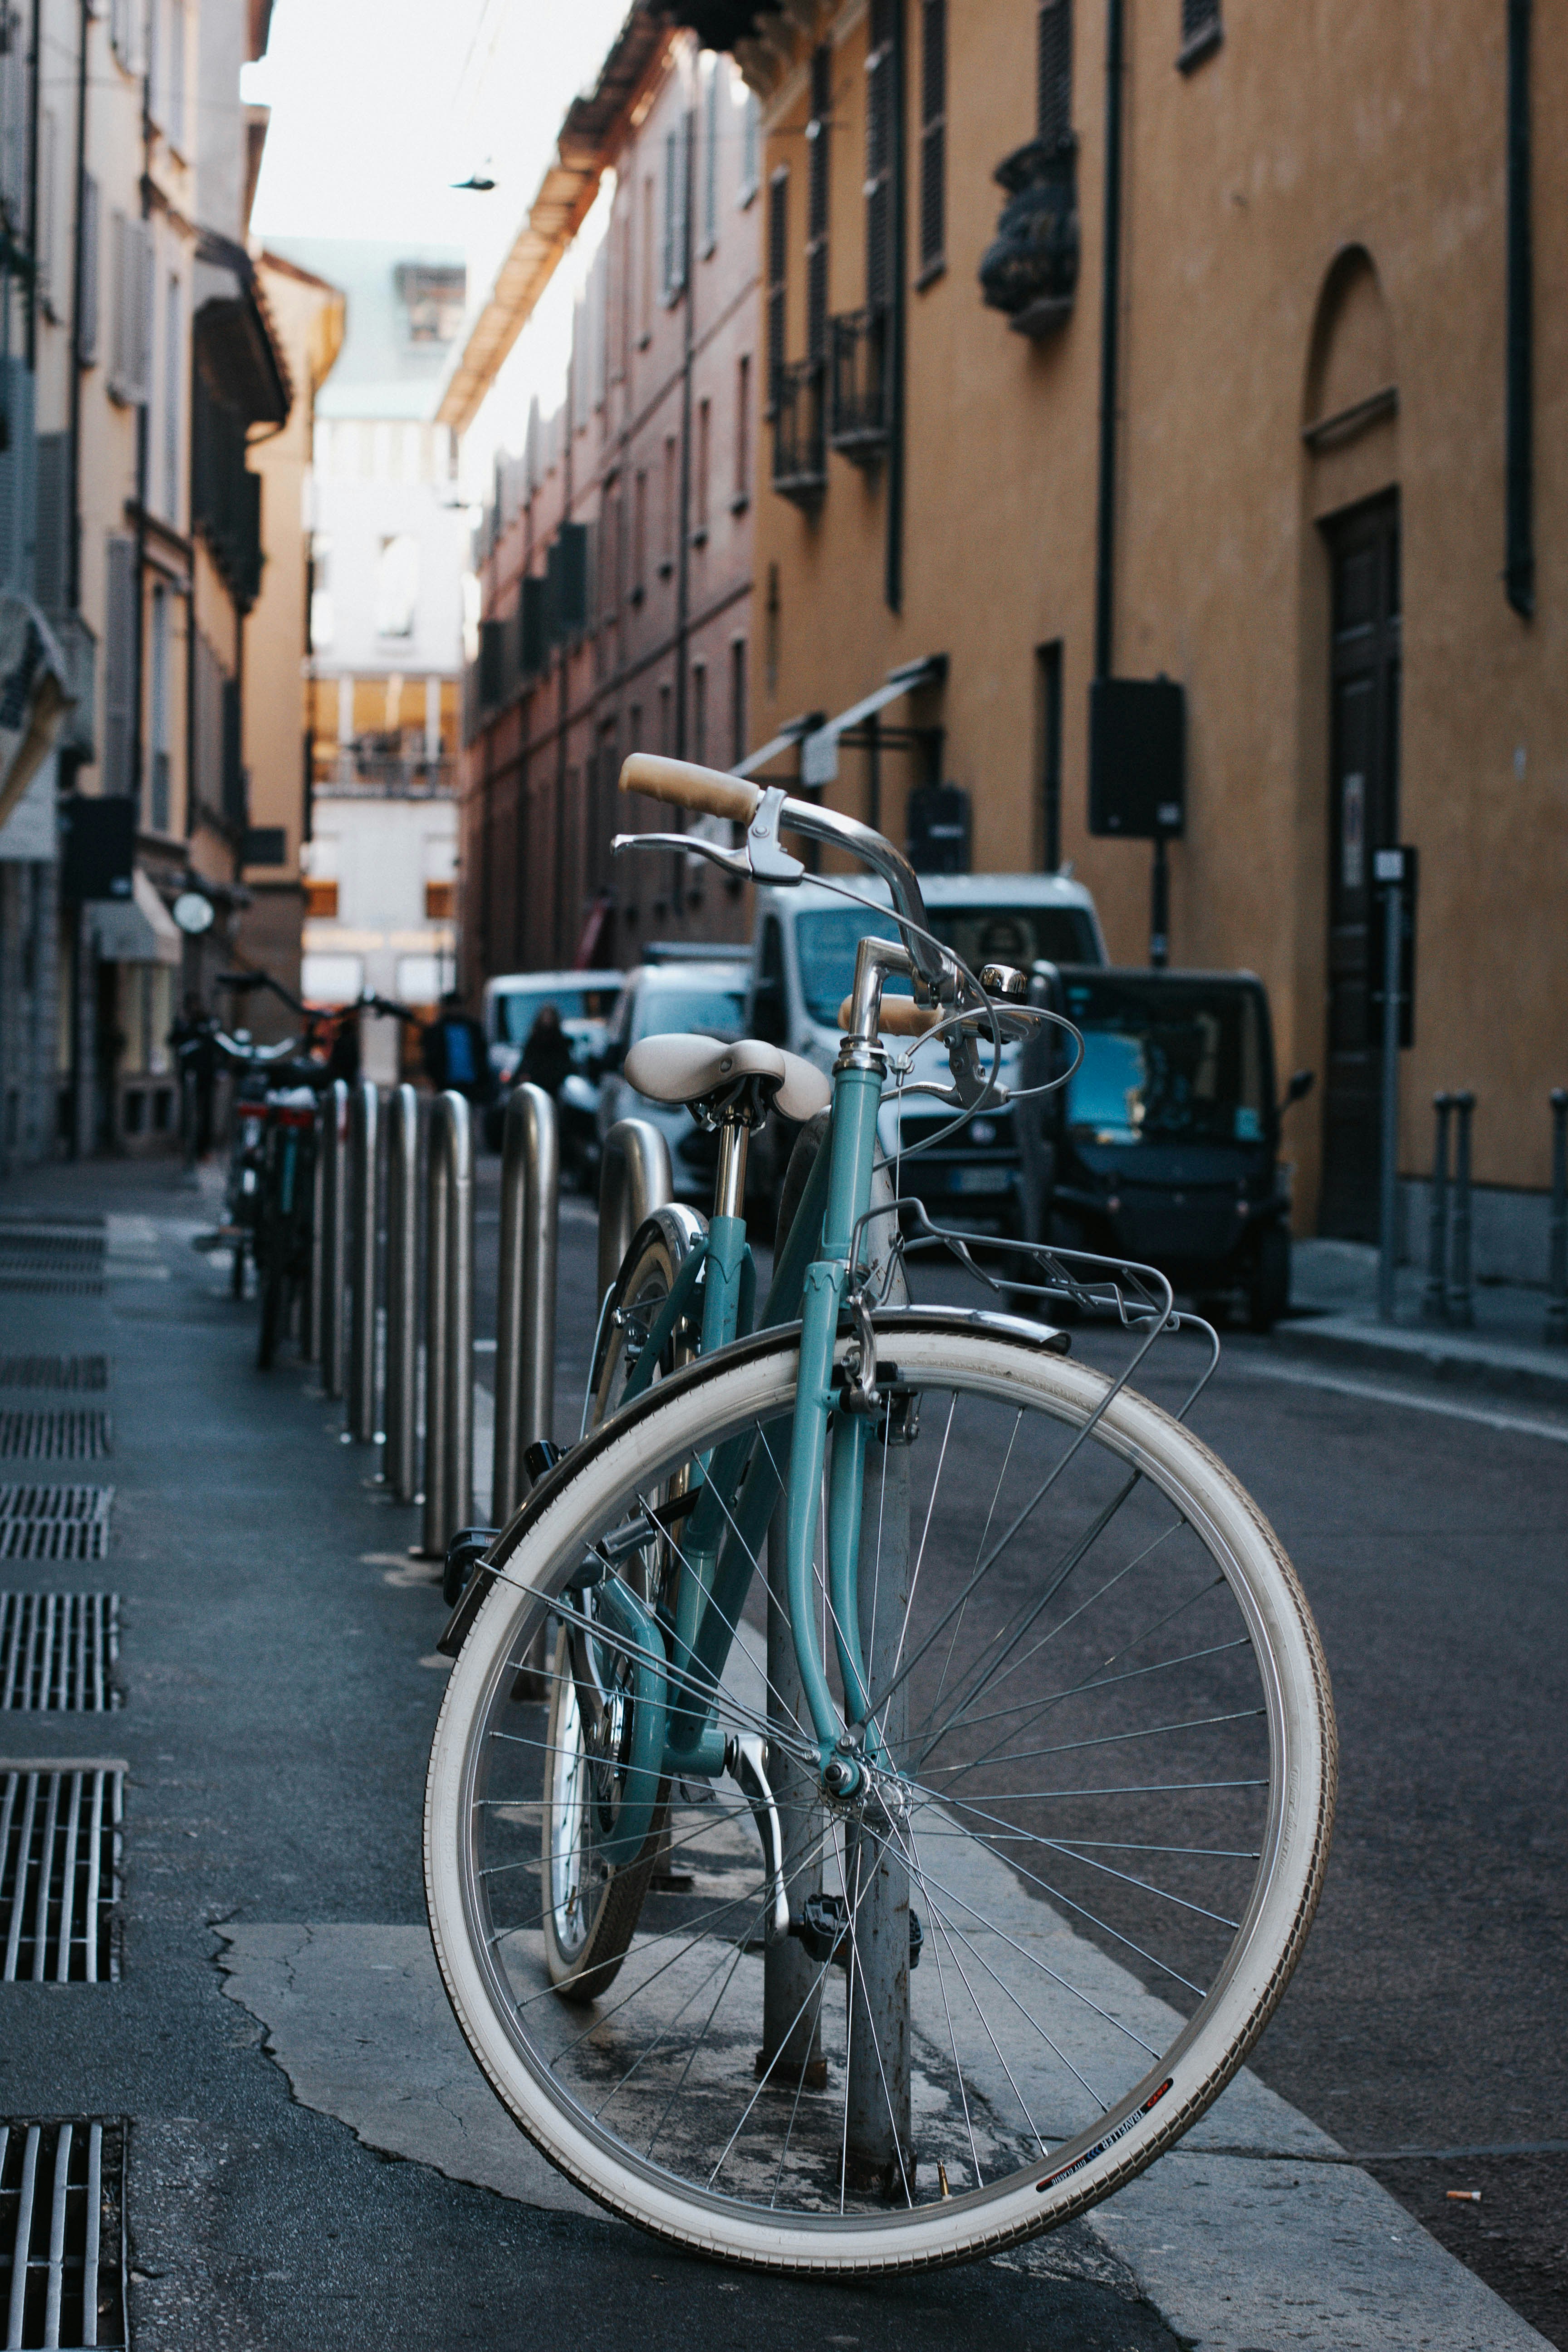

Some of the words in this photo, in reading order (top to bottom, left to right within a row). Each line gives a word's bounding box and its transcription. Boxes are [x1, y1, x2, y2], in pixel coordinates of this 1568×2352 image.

[1102, 2108, 1145, 2150] TRAVELLER
[1074, 2159, 1086, 2171] CITY
[1051, 2167, 1074, 2185] CLASSIC
